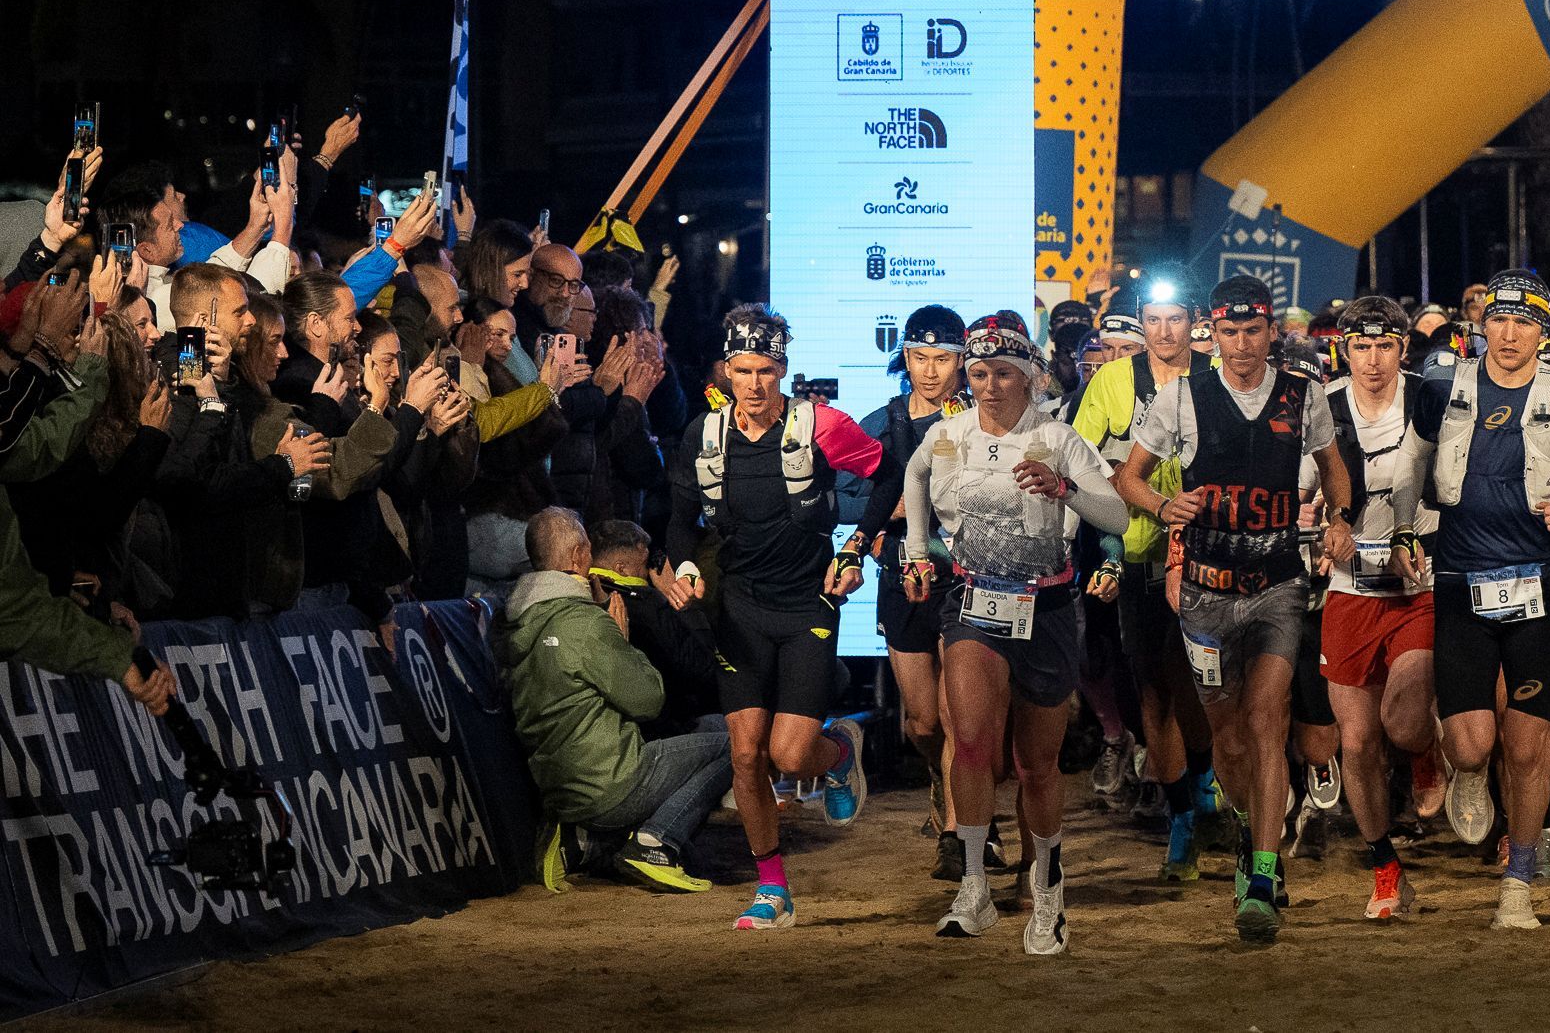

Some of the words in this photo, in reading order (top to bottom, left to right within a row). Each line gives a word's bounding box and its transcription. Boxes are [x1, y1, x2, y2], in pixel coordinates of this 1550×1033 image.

[847, 58, 879, 67] Cabildo
[881, 58, 892, 67] de
[843, 66, 864, 75] Gran
[866, 66, 897, 75] Canaria
[888, 108, 917, 121] THE
[864, 122, 917, 135] NORTH
[879, 136, 917, 149] FACE
[863, 202, 949, 215] GranCanaria
[889, 257, 936, 267] Gobierno
[889, 267, 901, 277] de
[902, 267, 946, 277] Canarias
[1201, 483, 1292, 531] OTSO
[1189, 560, 1233, 590] OTSO
[980, 590, 1008, 601] CLAUDIA
[1498, 589, 1509, 603] 8
[986, 600, 997, 616] 3
[280, 628, 404, 754] FACE
